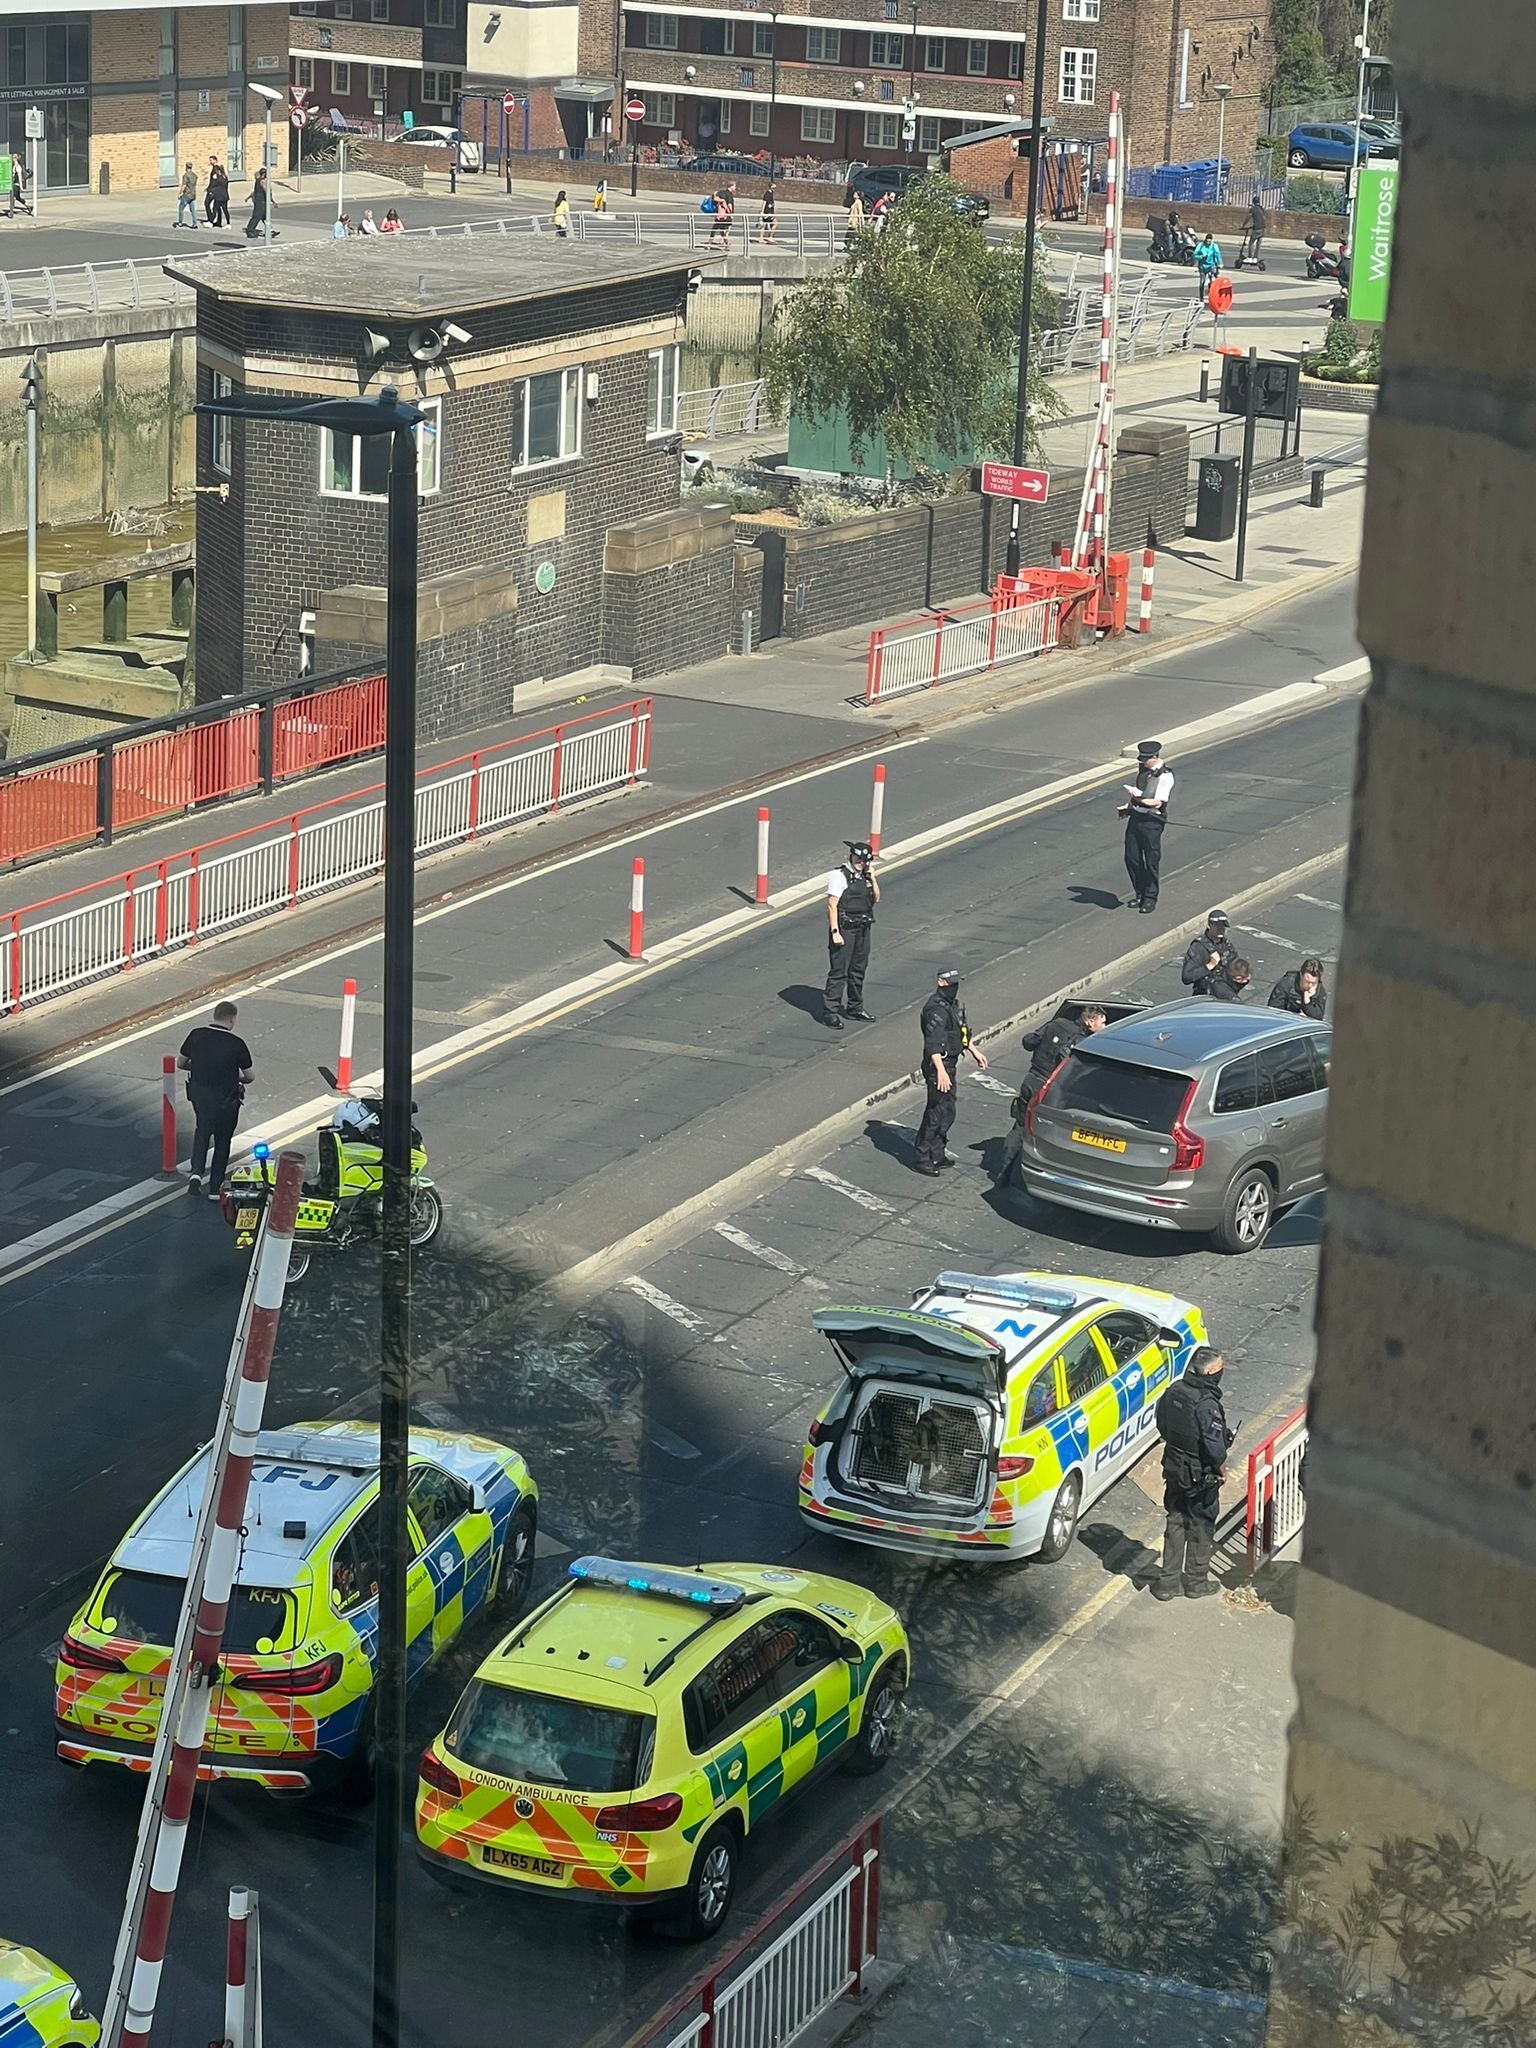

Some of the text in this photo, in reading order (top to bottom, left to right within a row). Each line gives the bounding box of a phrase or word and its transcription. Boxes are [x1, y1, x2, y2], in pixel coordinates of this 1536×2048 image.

[1369, 177, 1394, 281] Waitrose
[988, 467, 1018, 478] TIDEWAY
[991, 477, 1013, 485] WORKS
[990, 483, 1013, 492] TRAFFIC
[1094, 1402, 1156, 1472] POLIC
[248, 1588, 281, 1605] KFJ
[304, 1640, 327, 1660] KFJ
[93, 1713, 267, 1747] POCE
[469, 1771, 589, 1806] LONDON AMBULANCE
[597, 1832, 618, 1842] NHS
[492, 1848, 561, 1876] LX65 AGZ
